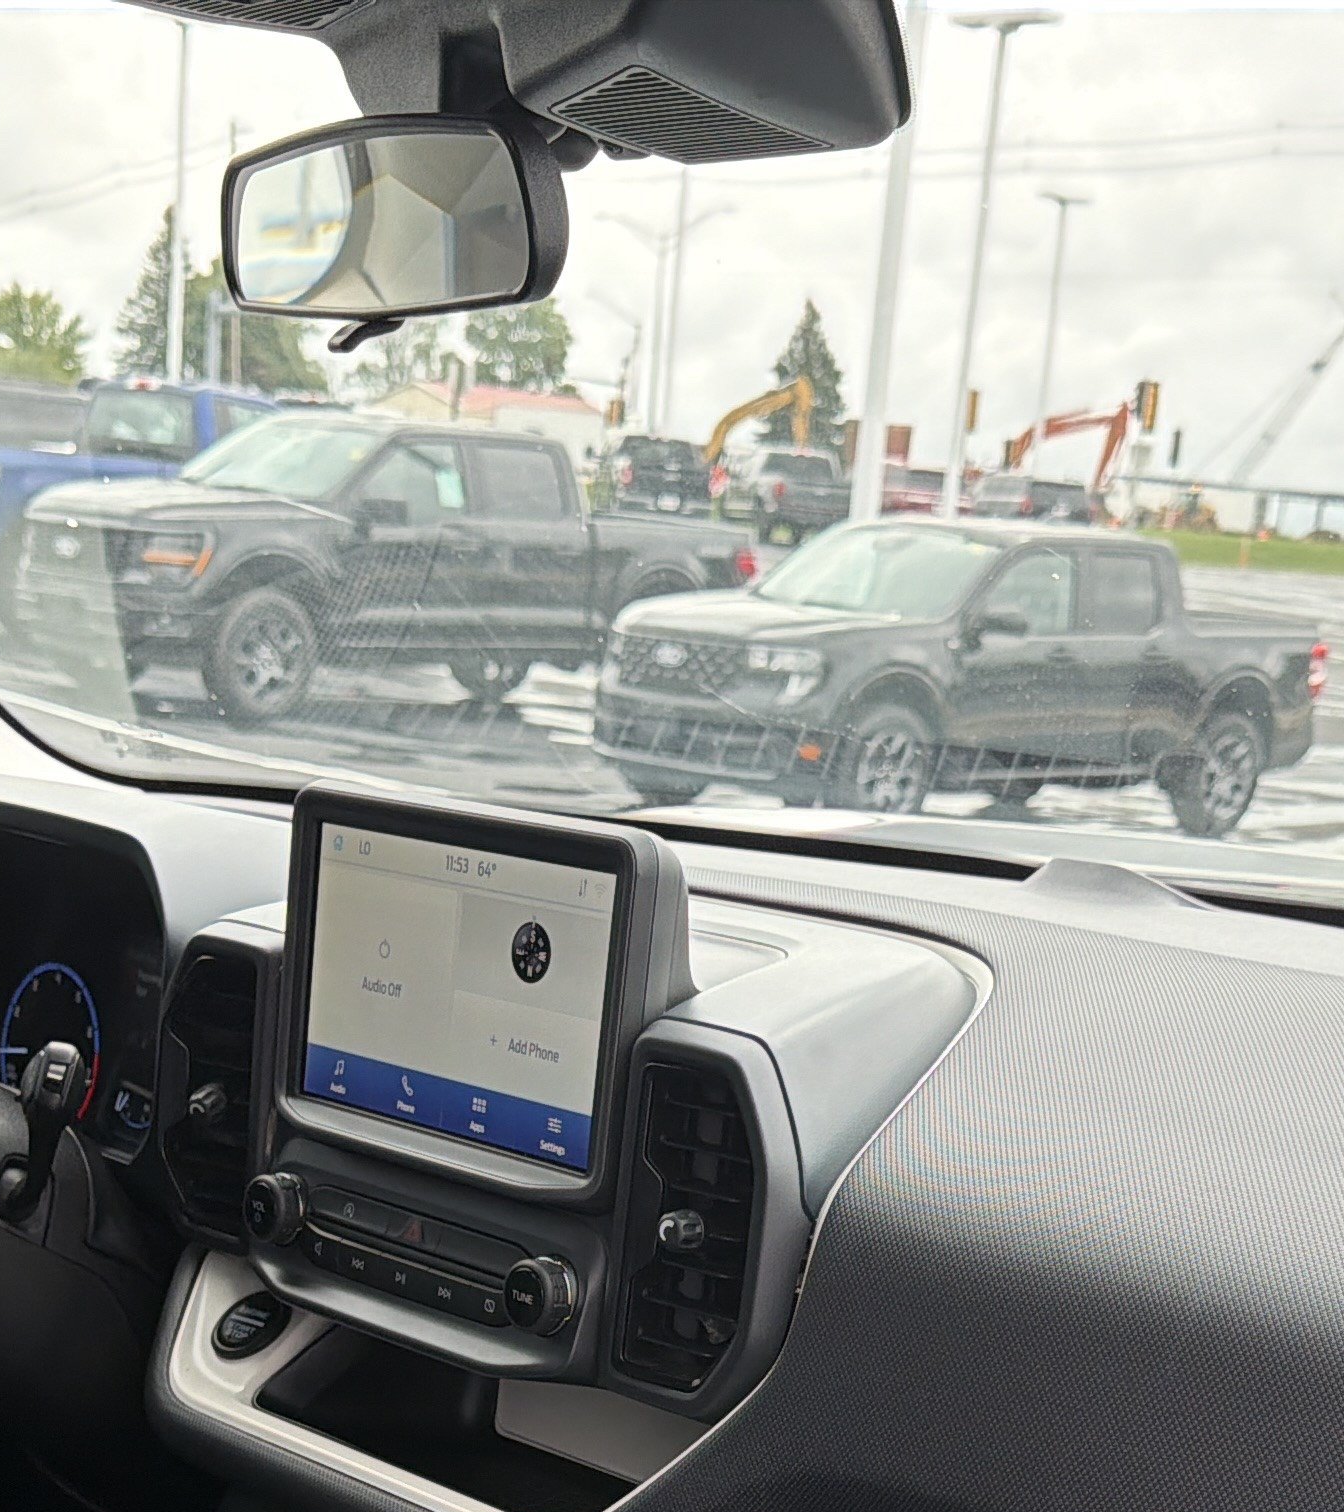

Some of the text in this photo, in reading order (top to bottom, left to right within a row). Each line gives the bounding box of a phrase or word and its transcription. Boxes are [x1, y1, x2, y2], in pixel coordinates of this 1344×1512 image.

[446, 855, 469, 874] 11:53
[362, 976, 402, 999] Audio Off
[508, 1038, 560, 1063] Add Phone
[397, 1100, 415, 1114] Phone
[469, 1120, 485, 1134] Apps
[540, 1140, 565, 1156] Settings
[512, 1290, 534, 1305] TUNE
